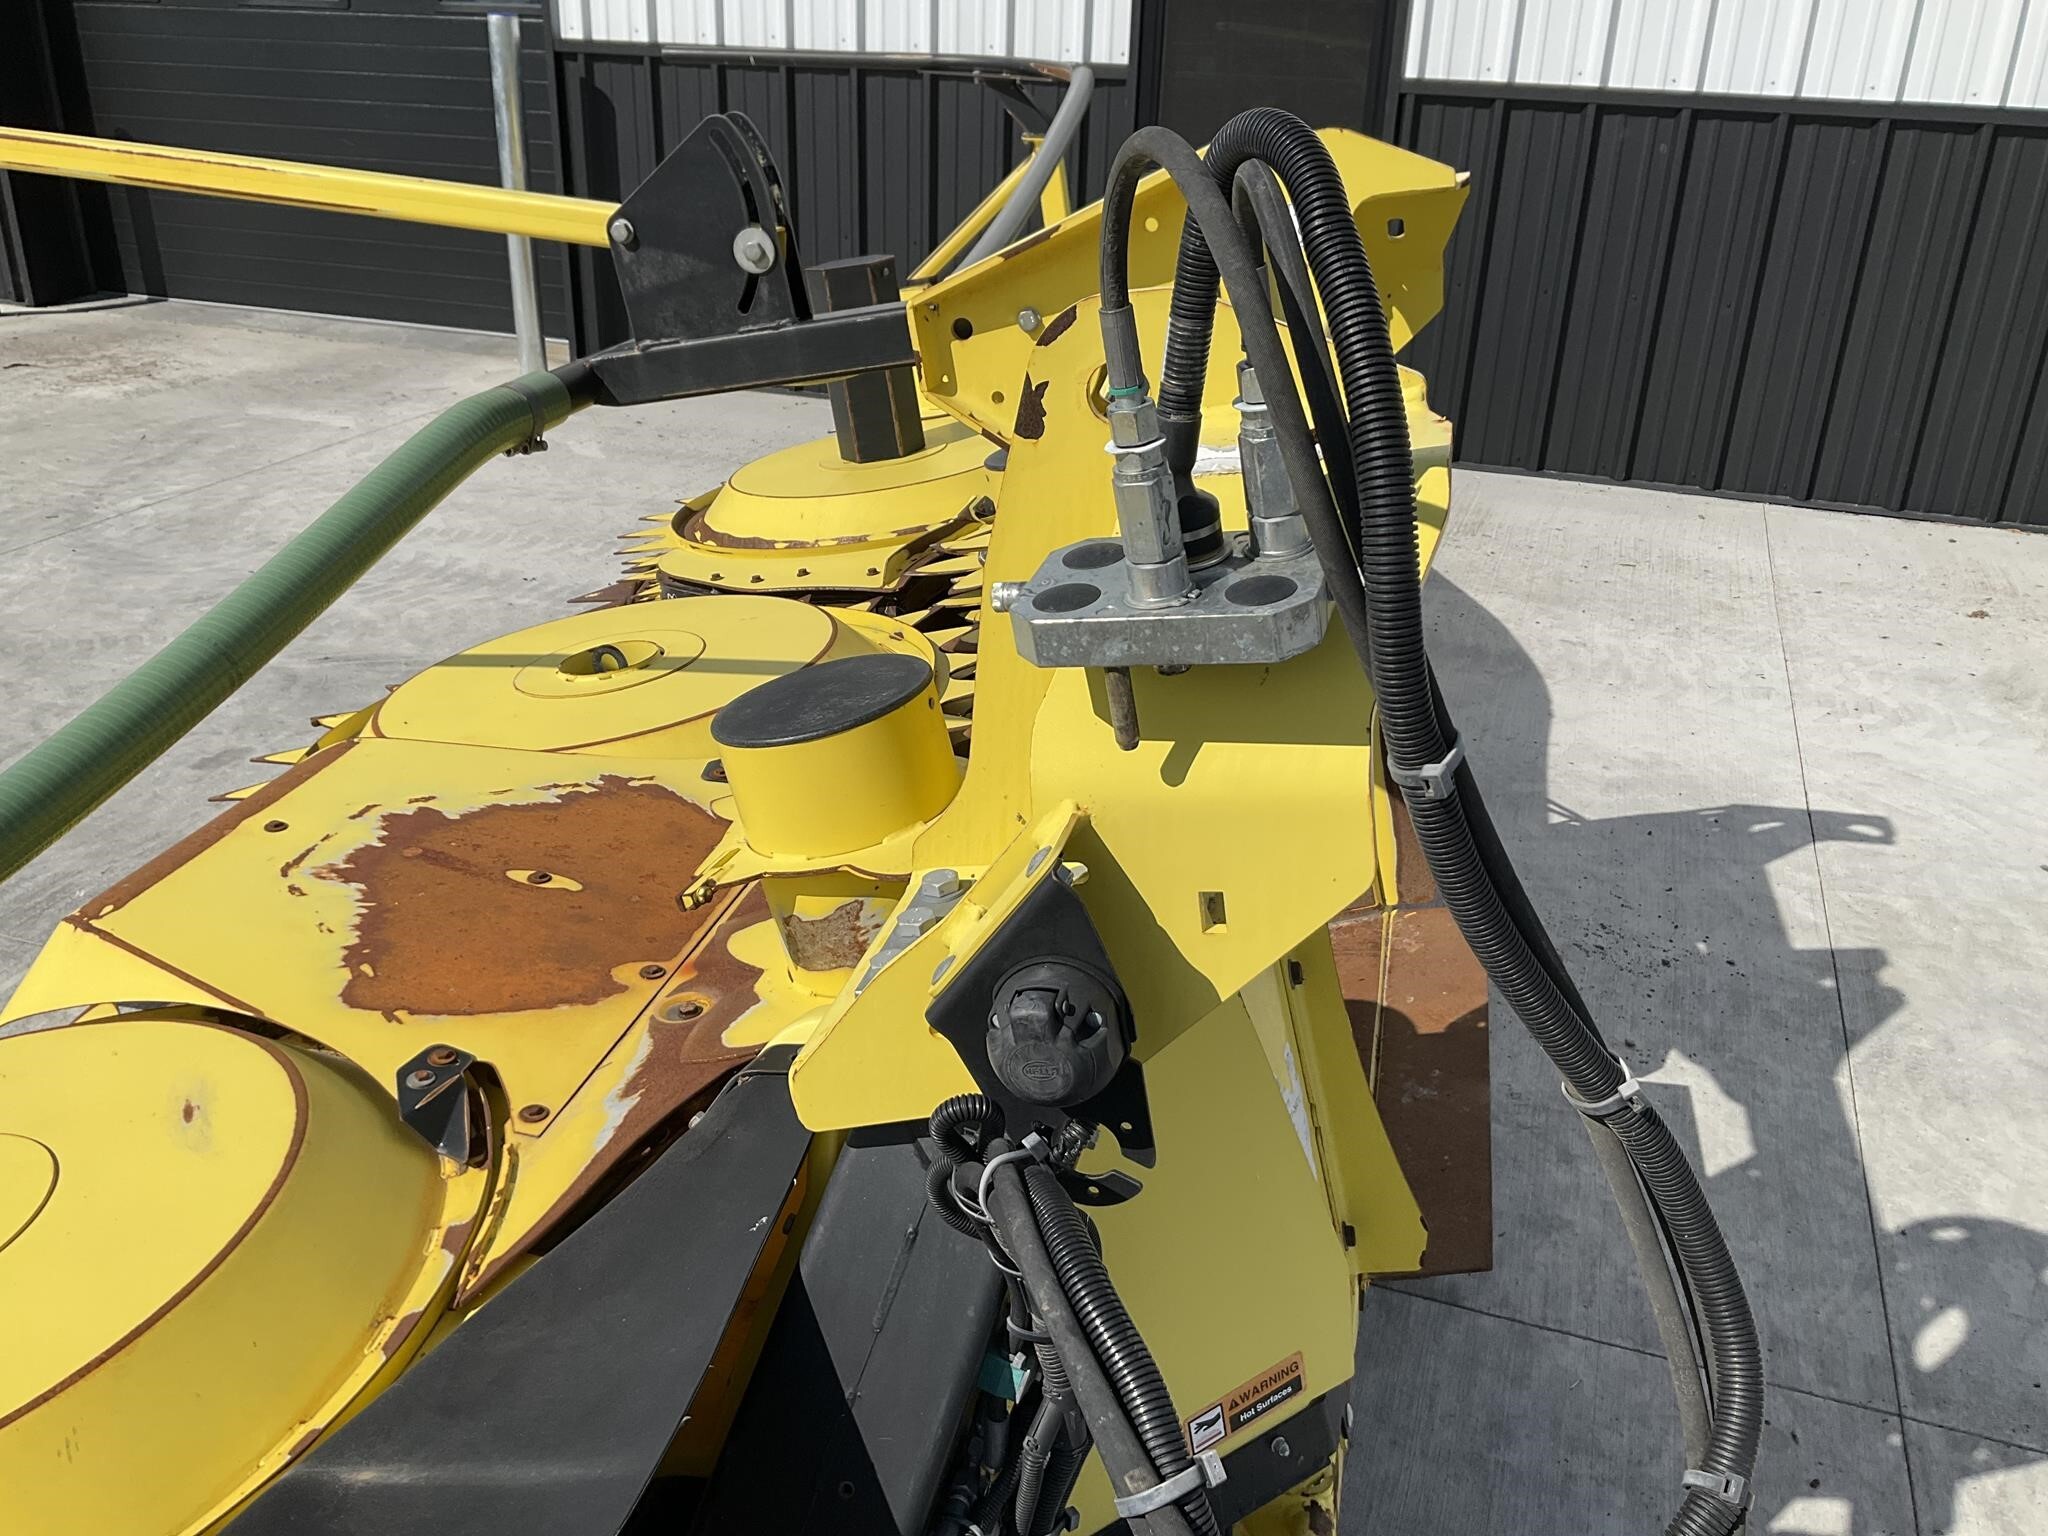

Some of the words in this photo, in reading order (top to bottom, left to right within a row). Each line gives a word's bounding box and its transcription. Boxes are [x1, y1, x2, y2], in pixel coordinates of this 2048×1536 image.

[1239, 1361, 1299, 1404] WARNING
[1240, 1408, 1256, 1422] Hot
[1256, 1385, 1293, 1412] Surfaces
